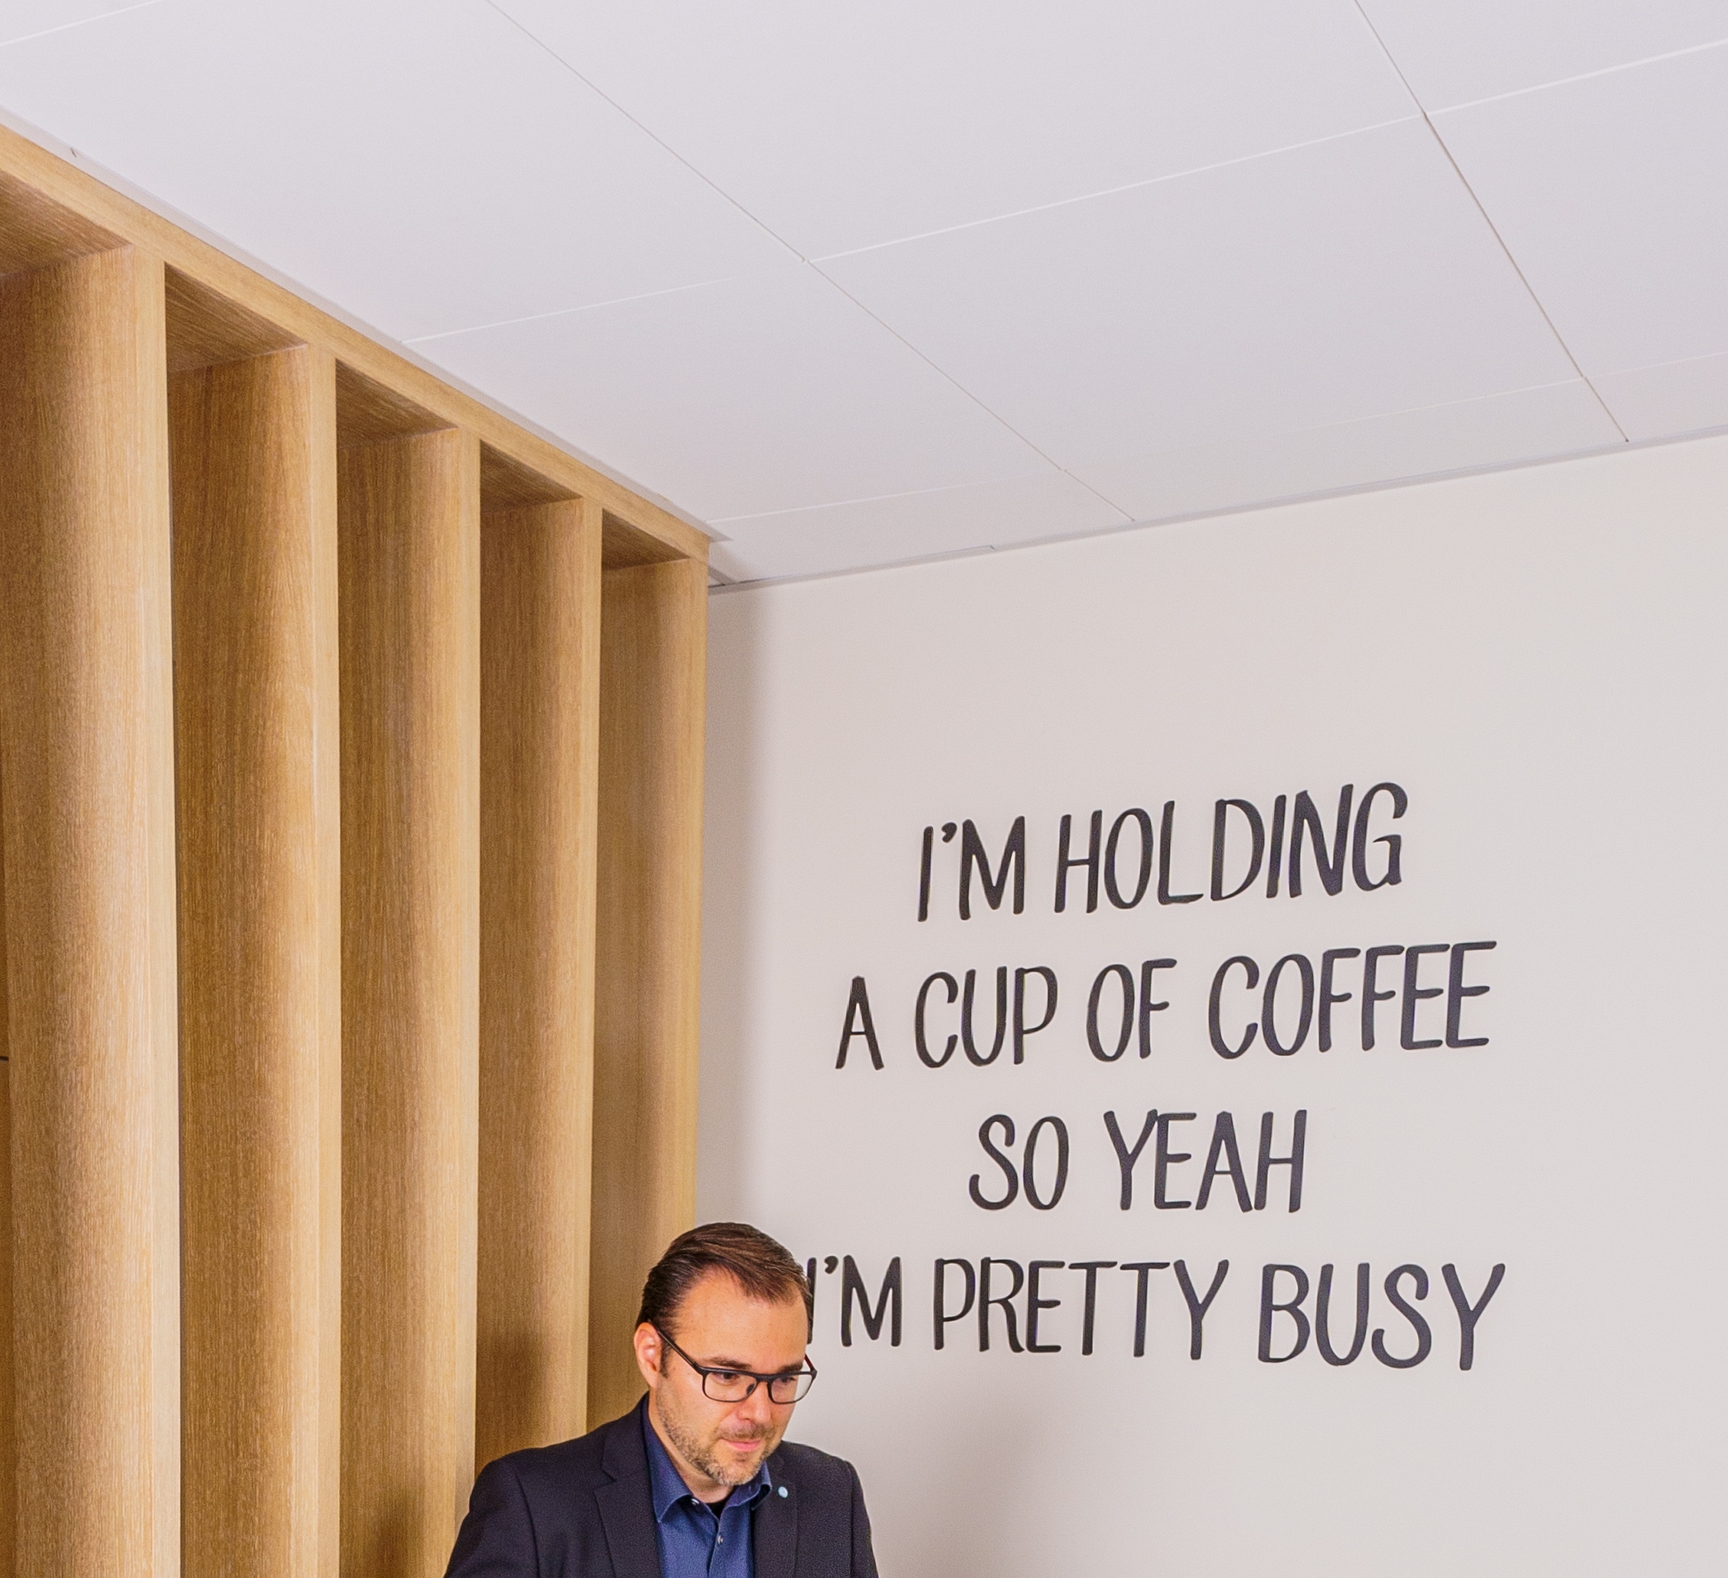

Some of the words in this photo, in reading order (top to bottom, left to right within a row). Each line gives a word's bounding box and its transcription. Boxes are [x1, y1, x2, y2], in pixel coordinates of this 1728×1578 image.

[1054, 782, 1408, 914] HOLDING
[835, 975, 885, 1071] A
[914, 965, 1058, 1069] CUP
[1086, 958, 1178, 1063] OF
[1208, 940, 1497, 1060] COFFEE
[968, 1113, 1070, 1211] SO
[1103, 1108, 1308, 1214] YEAH
[933, 1256, 1230, 1361] PRETTY
[1257, 1262, 1506, 1371] BUSY
